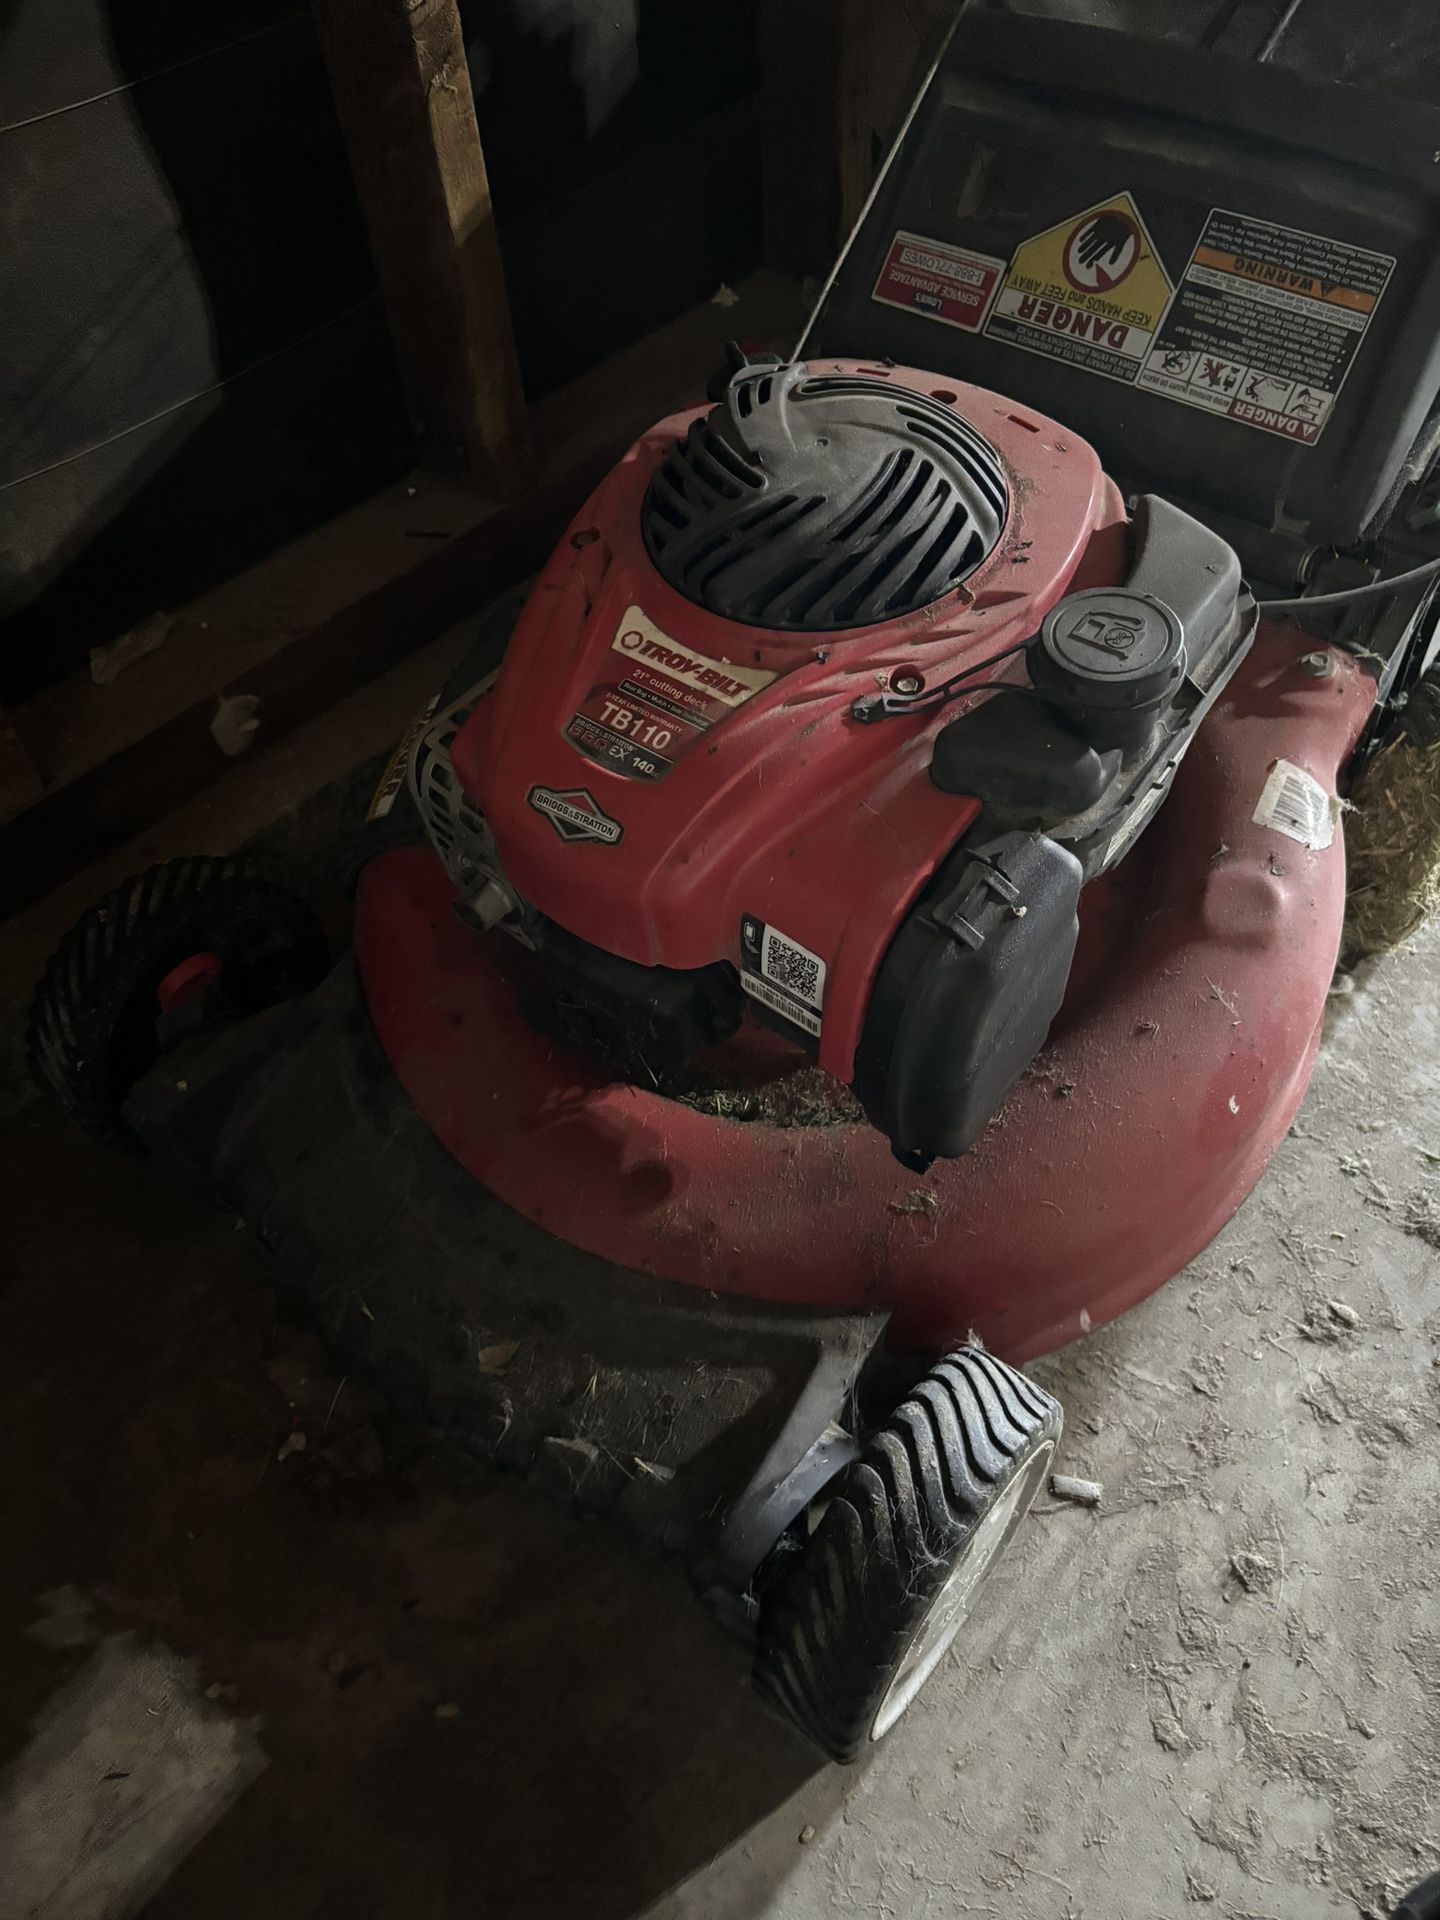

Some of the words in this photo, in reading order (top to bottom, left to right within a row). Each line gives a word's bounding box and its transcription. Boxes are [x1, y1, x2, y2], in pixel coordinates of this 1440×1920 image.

[886, 268, 941, 294] ADVANTAGE
[1010, 273, 1041, 292] AWAY
[1230, 257, 1315, 292] WARNING
[940, 285, 980, 306] SERVICE
[1040, 283, 1066, 300] FEET
[1067, 291, 1086, 306] and
[1085, 296, 1122, 317] HANDS
[1121, 307, 1152, 327] KEEP
[1015, 294, 1130, 349] DANGER
[1232, 401, 1299, 433] DANGER
[638, 641, 752, 698] TROY-BILT
[649, 676, 683, 701] cutting
[684, 691, 708, 710] deck
[598, 702, 671, 750] TB110
[536, 793, 615, 836] BRIGGS&STRATTON
